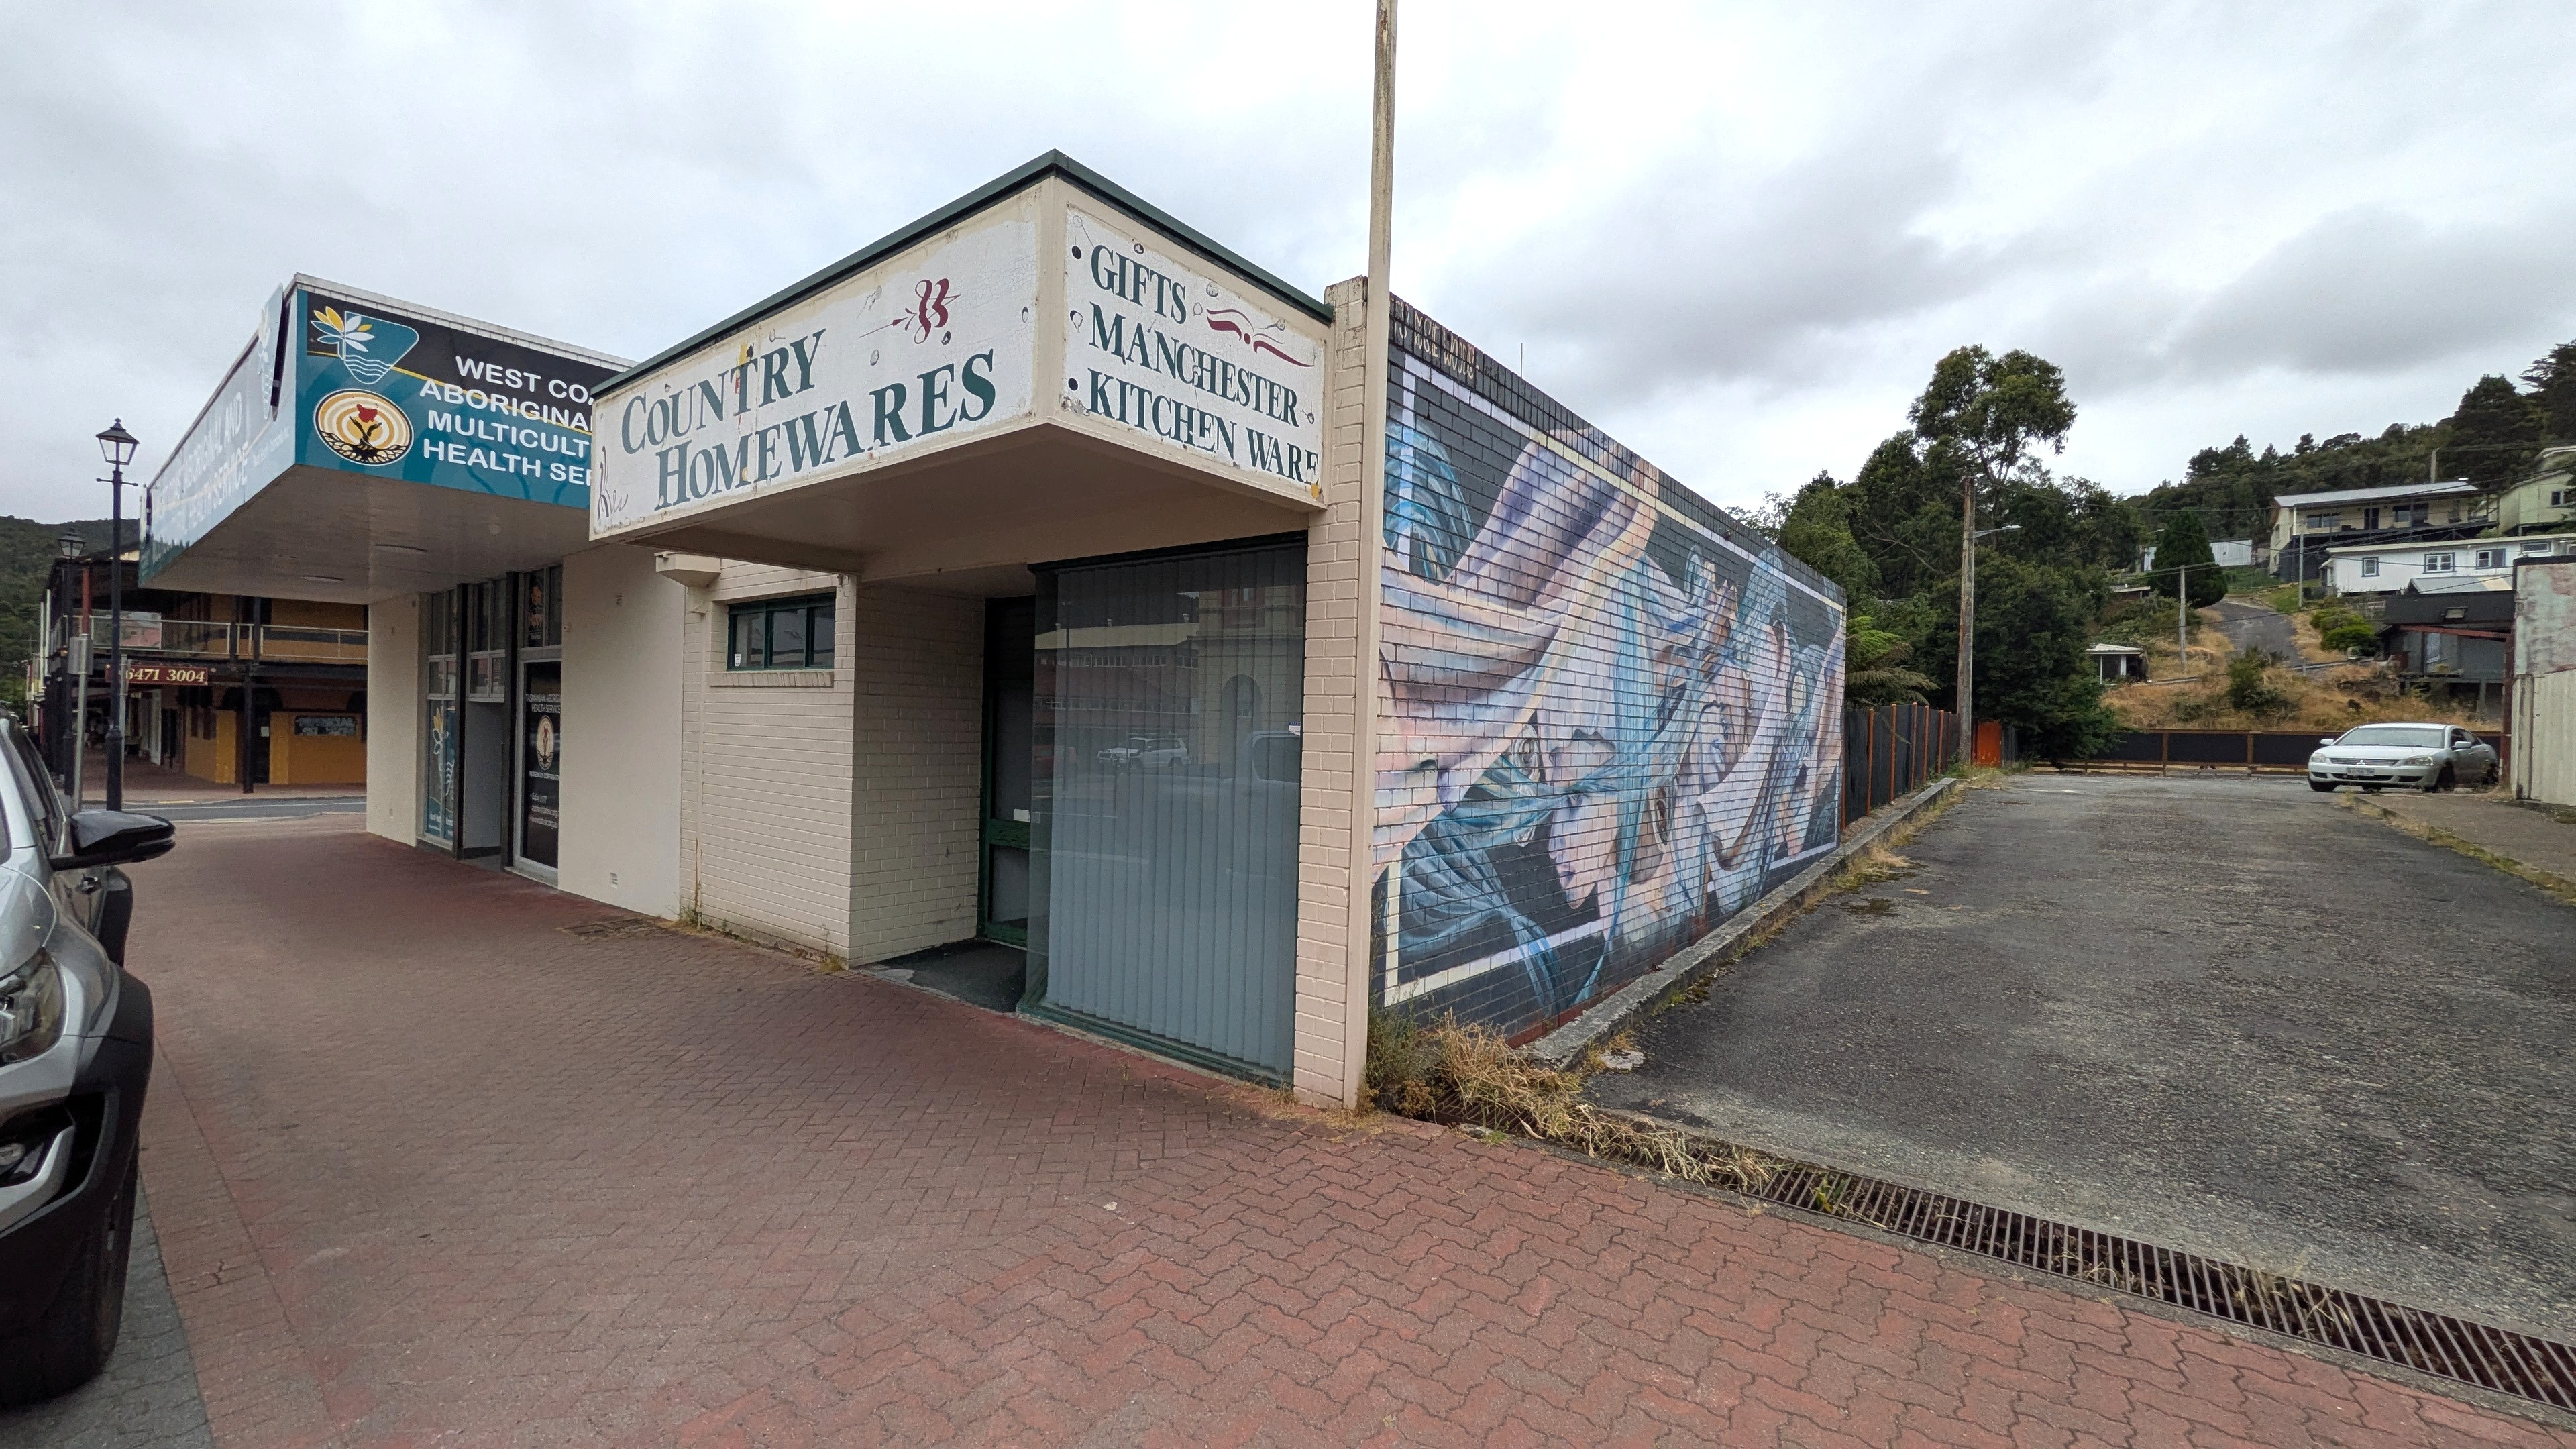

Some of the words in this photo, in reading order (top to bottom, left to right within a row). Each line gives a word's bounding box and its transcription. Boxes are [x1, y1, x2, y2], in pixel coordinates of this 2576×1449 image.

[1091, 244, 1187, 325] GIFTS
[456, 355, 541, 392] WEST
[549, 379, 594, 405] CO
[621, 328, 826, 455] COUNTRY
[1089, 301, 1299, 428] MANCHESTER
[428, 410, 590, 458] MULTICULT
[654, 348, 996, 512] HOMEWARES
[1087, 367, 1237, 460] KITCHEN
[423, 439, 541, 478] HEALTH
[166, 669, 205, 682] 3004
